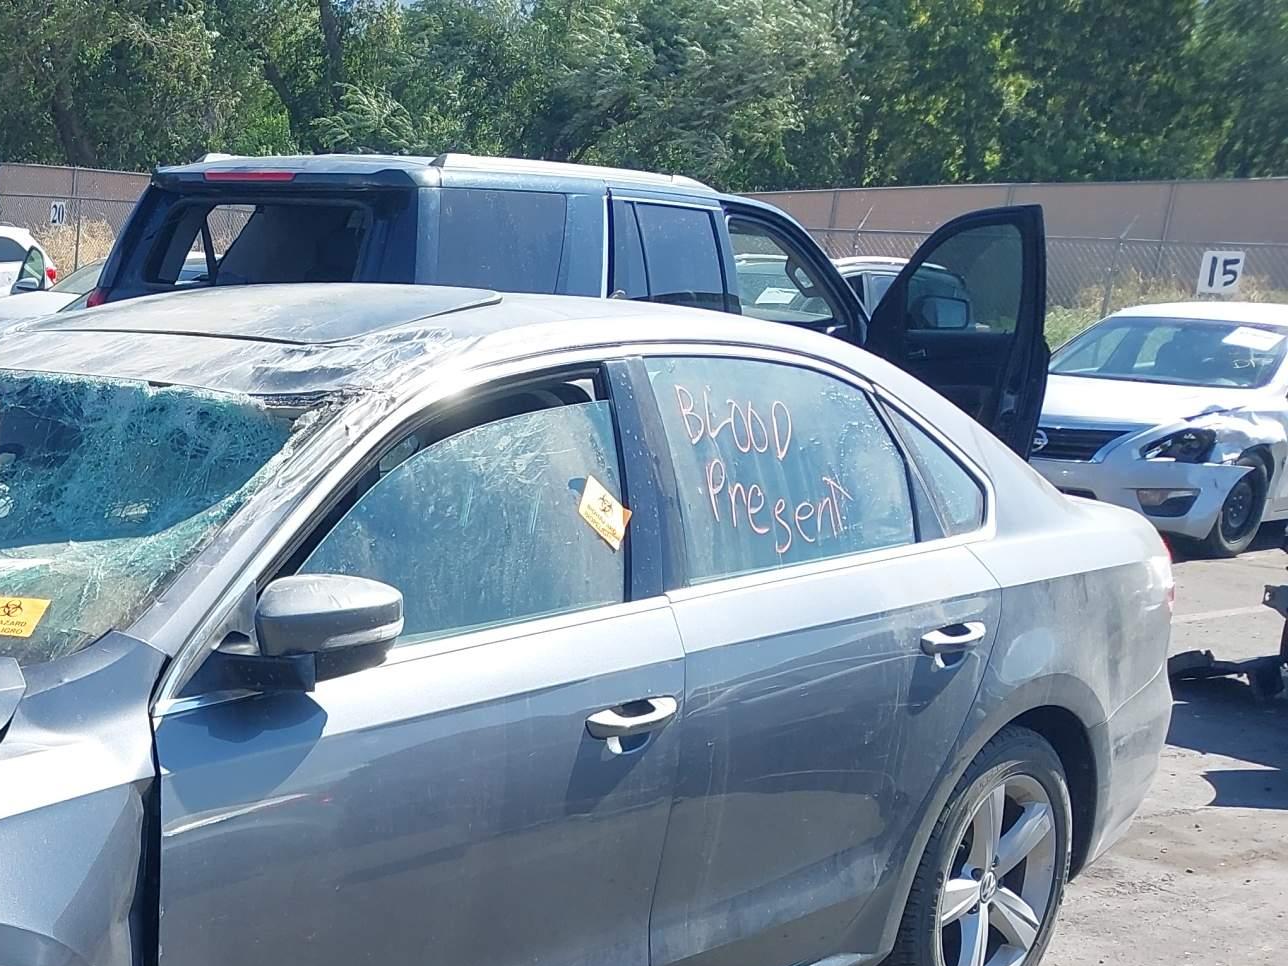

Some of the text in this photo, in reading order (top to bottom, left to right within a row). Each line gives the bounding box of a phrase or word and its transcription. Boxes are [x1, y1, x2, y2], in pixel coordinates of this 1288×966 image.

[52, 204, 64, 224] 20
[1207, 256, 1241, 288] 15
[674, 384, 792, 461] BLOOD
[705, 459, 854, 554] Present
